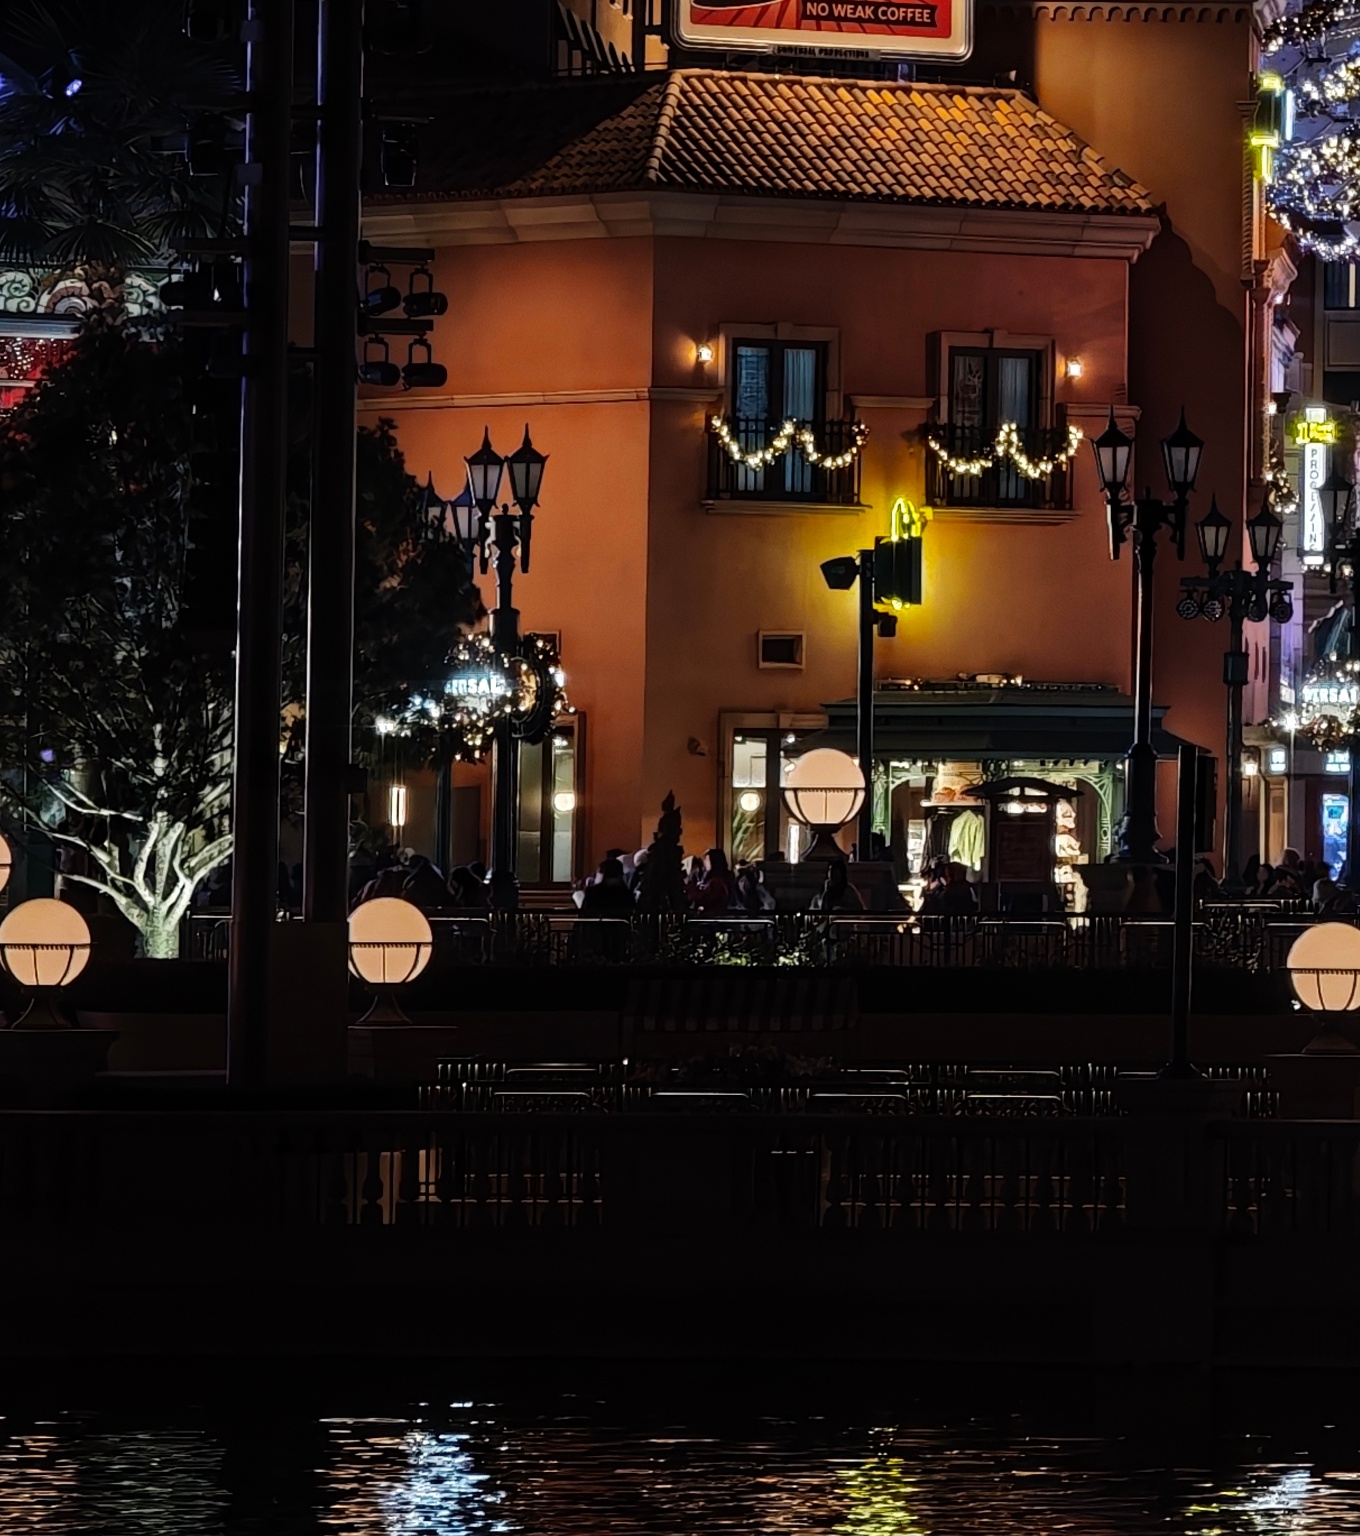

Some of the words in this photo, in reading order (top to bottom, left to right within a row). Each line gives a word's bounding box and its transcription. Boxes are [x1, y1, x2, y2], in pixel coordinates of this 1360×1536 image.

[806, 1, 830, 17] NO
[832, 3, 876, 20] WEAK
[877, 5, 932, 24] COFFEE
